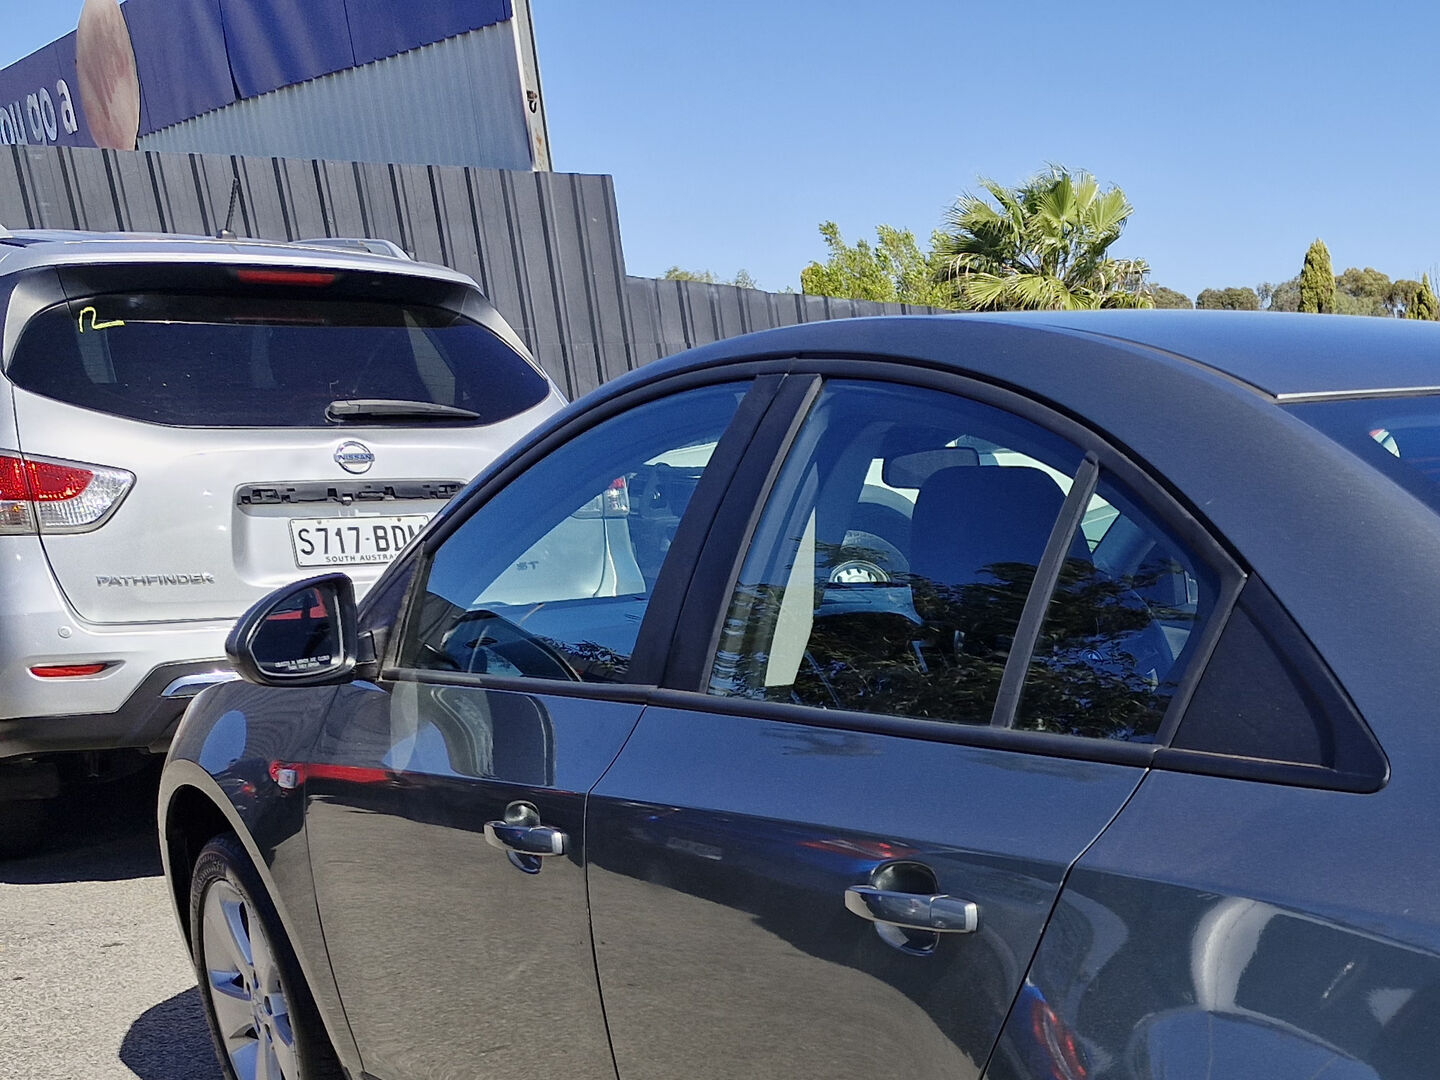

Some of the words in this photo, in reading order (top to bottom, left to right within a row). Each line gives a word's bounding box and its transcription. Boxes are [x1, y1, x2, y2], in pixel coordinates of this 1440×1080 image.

[27, 87, 57, 146] go
[56, 79, 78, 134] a
[325, 555, 356, 563] SOUTH
[359, 553, 398, 562] AUSTRA
[96, 574, 216, 587] PATHFINDER
